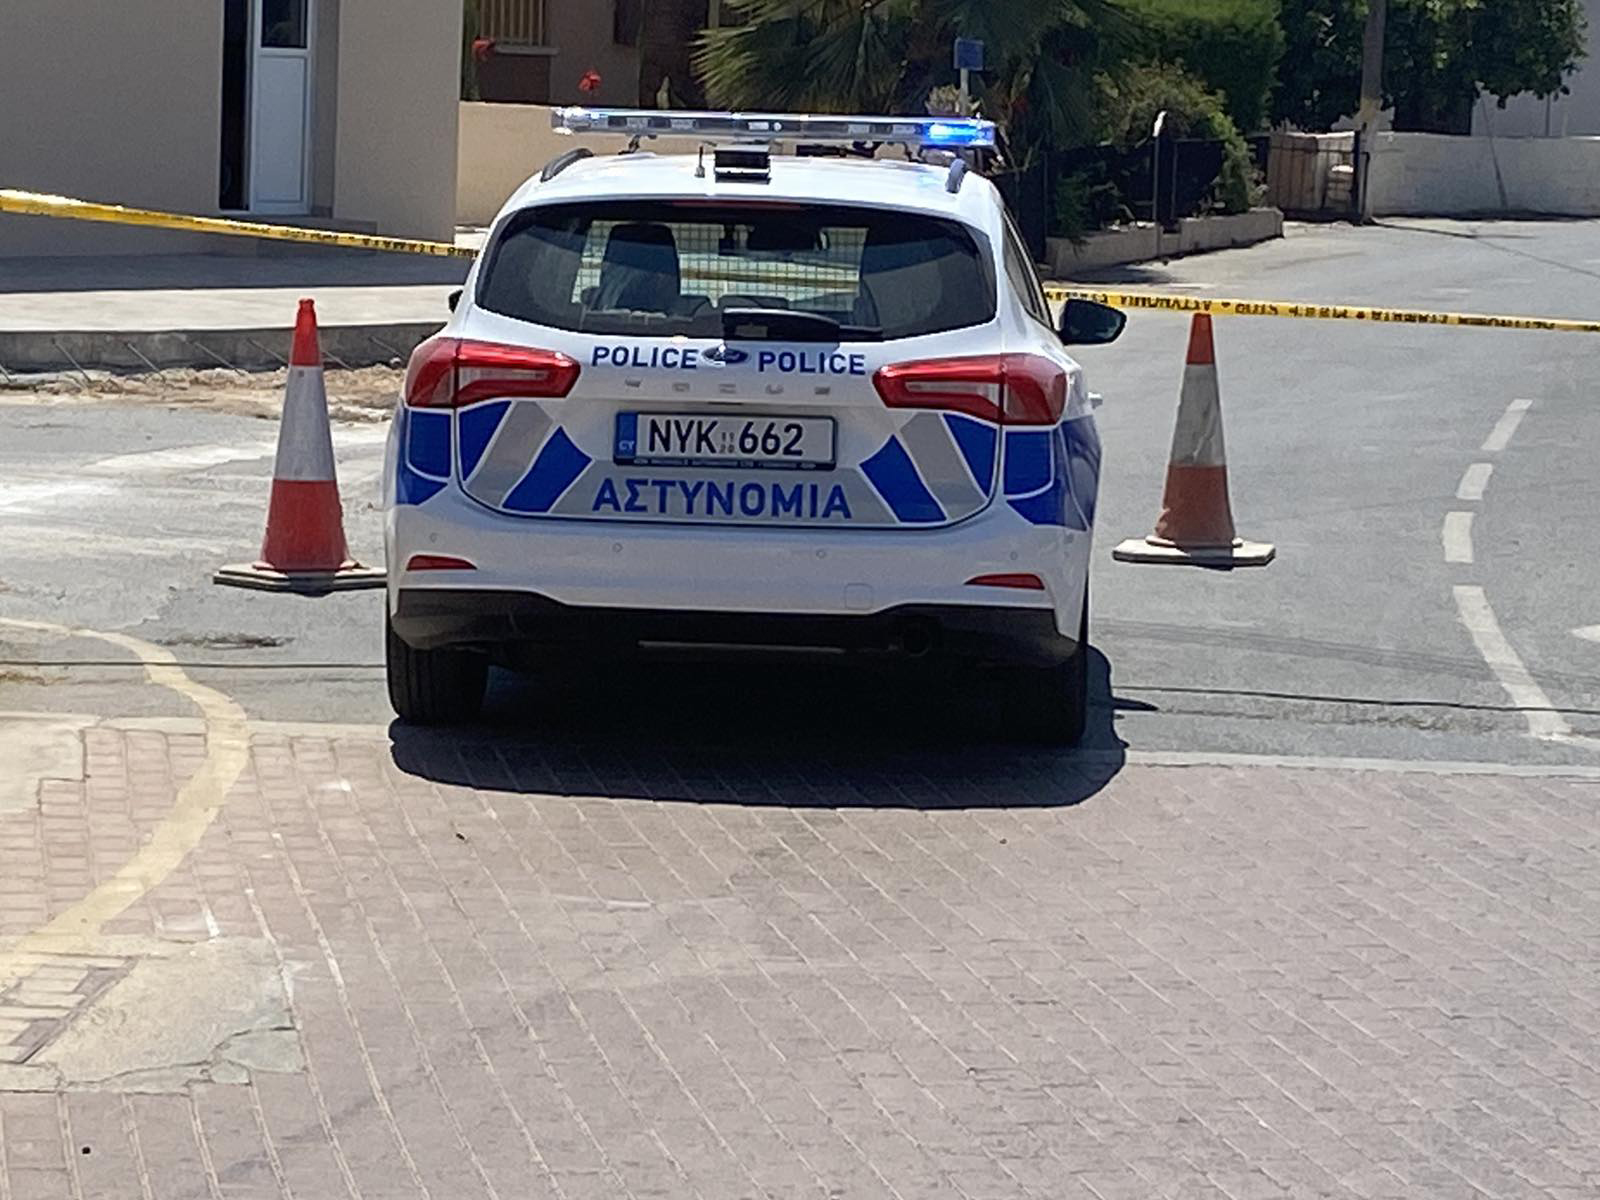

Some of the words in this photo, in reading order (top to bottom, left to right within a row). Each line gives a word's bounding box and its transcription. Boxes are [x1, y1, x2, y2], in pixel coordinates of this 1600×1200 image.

[592, 346, 699, 369] POLICE
[759, 351, 866, 375] POLICE
[619, 440, 635, 450] CY
[649, 419, 718, 453] NYK
[739, 422, 804, 456] 662
[592, 478, 851, 519] ΑΣΤΥΝΟΜΙΑ
